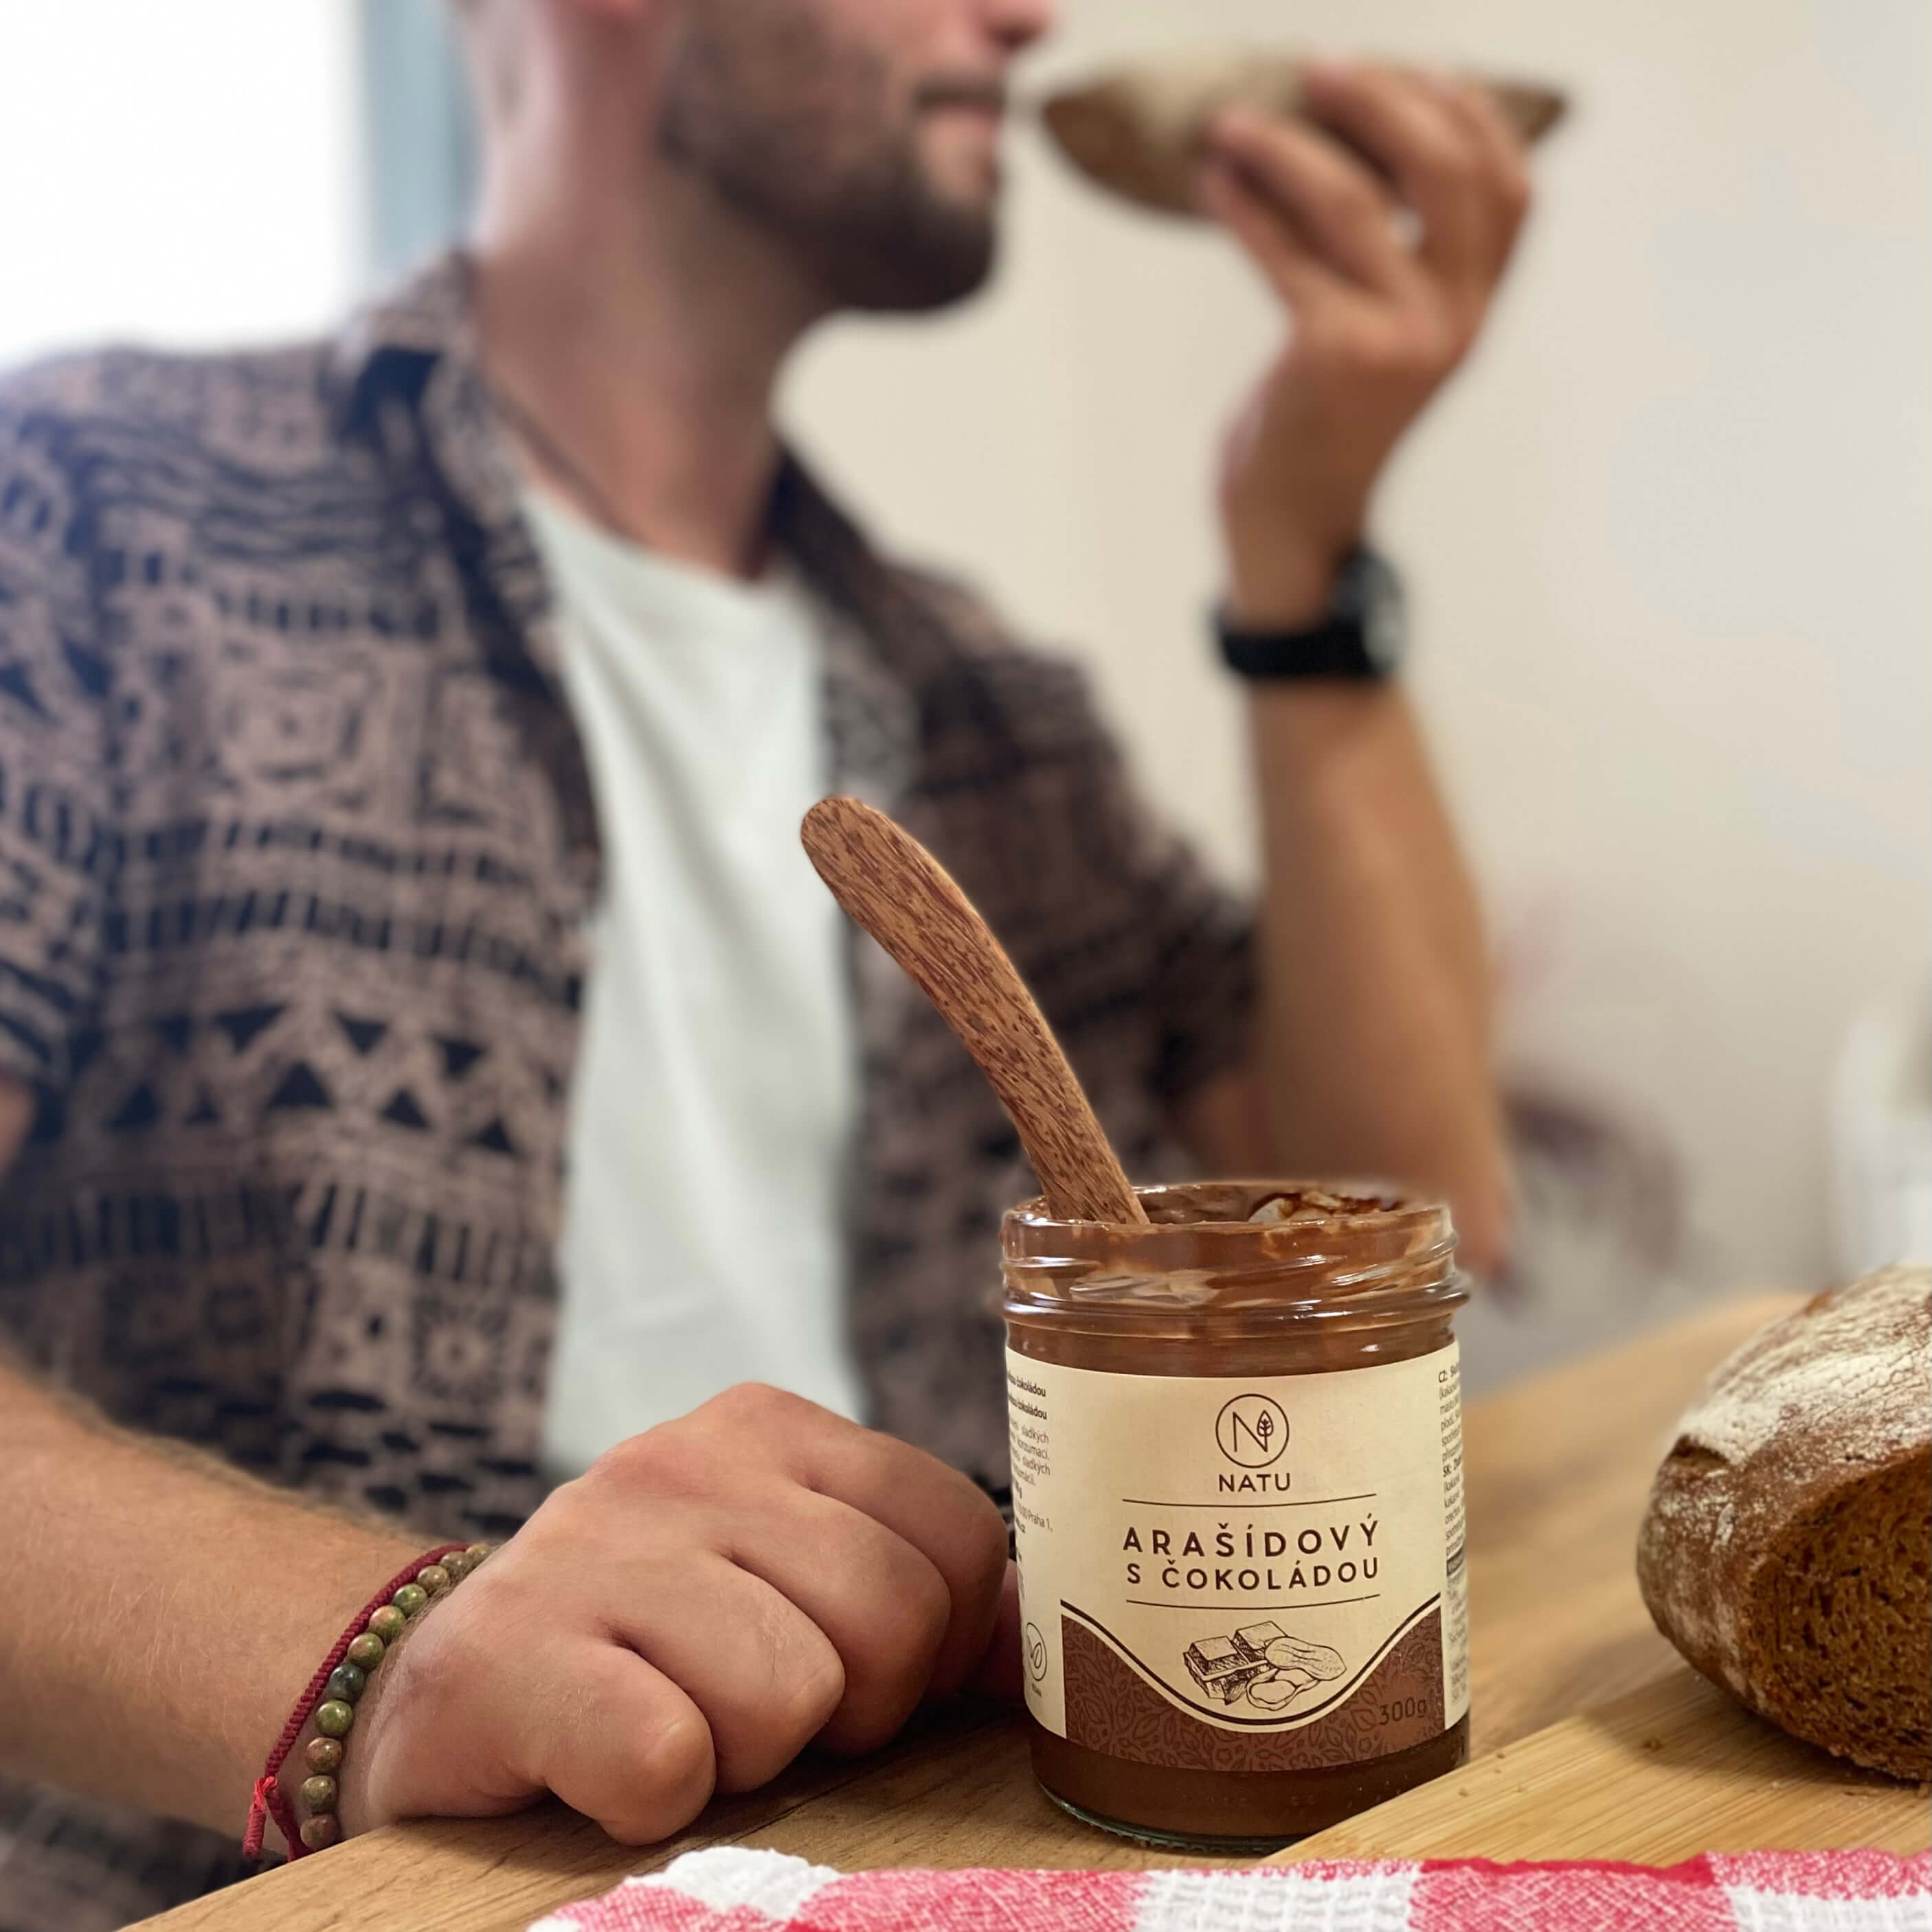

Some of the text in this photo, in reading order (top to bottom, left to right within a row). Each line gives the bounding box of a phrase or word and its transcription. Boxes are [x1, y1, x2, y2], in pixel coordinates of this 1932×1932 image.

[1218, 1472, 1291, 1492] NATU
[1028, 1509, 1045, 1529] Praha
[1123, 1513, 1378, 1558] ARAŠÍDOVÝ
[1127, 1557, 1378, 1591] S ČOKOLÁDOU
[1379, 1696, 1426, 1725] 300g
